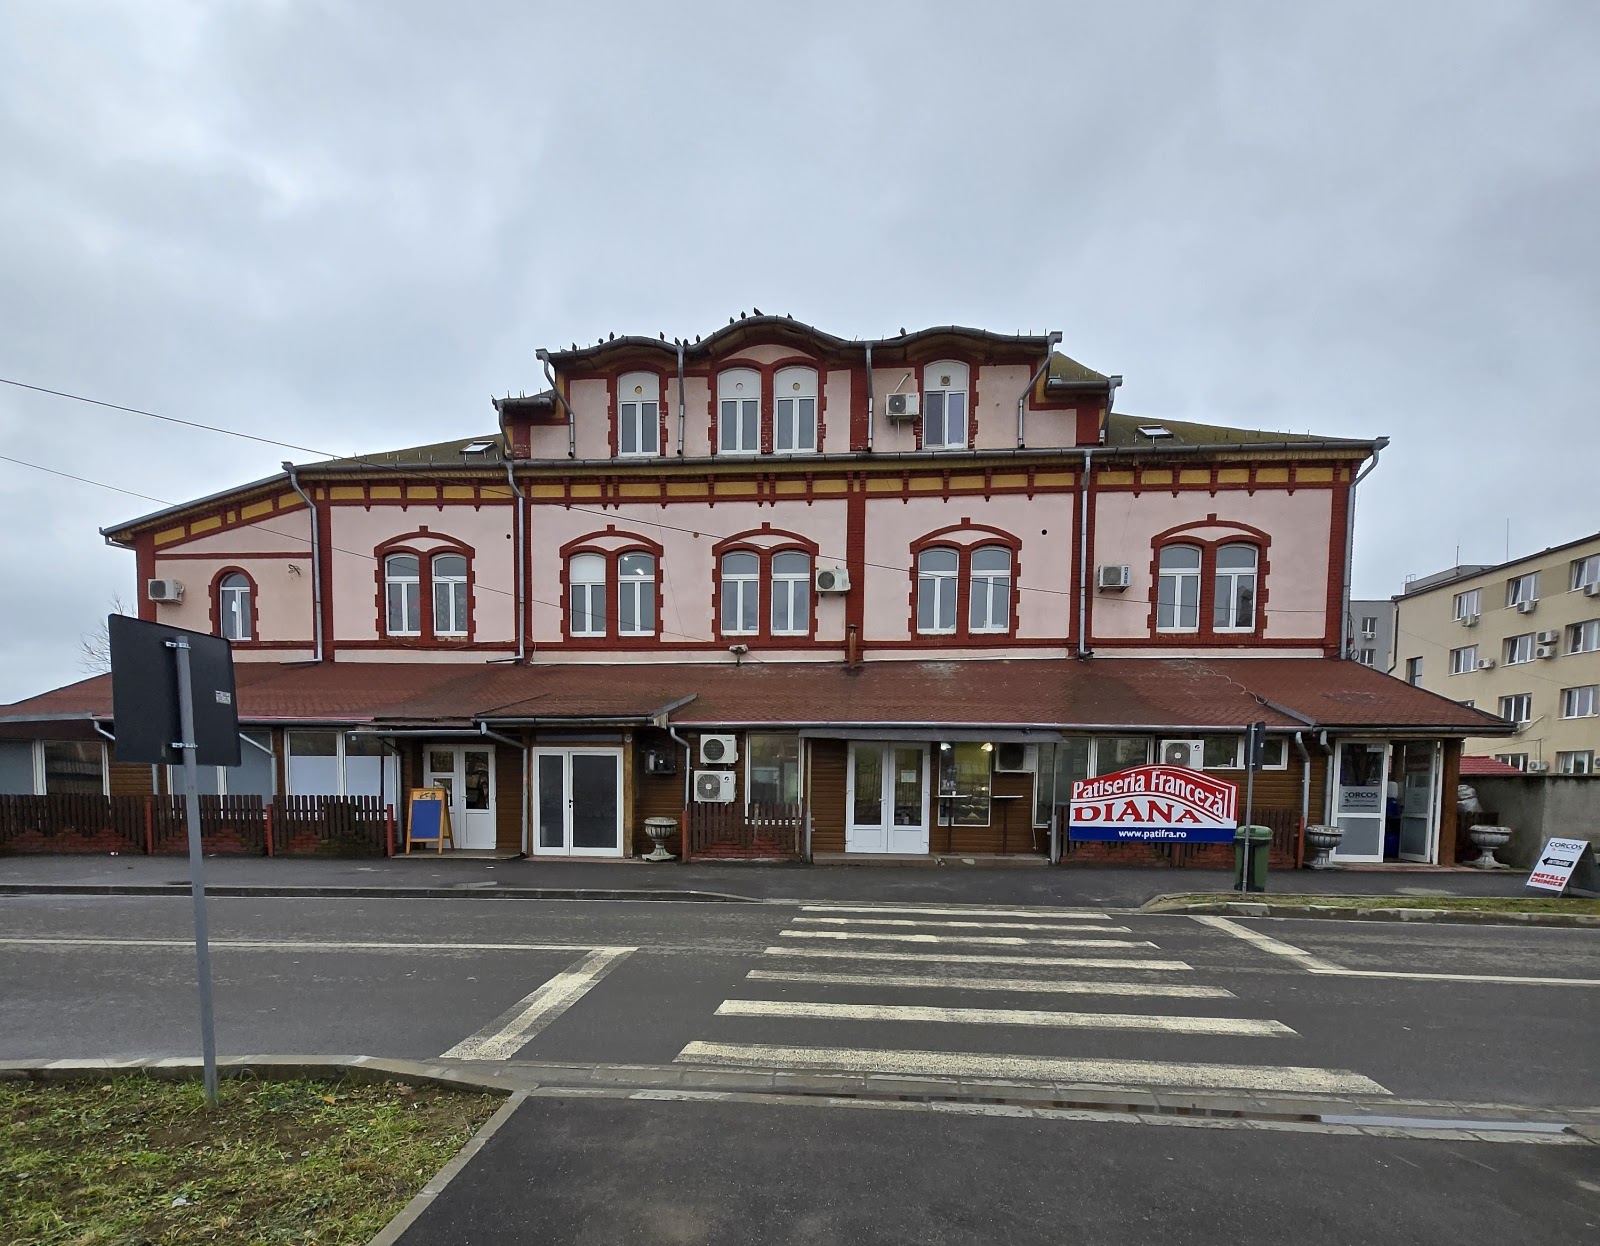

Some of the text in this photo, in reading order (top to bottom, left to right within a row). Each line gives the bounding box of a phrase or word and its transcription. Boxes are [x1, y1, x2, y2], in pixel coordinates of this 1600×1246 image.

[1073, 771, 1224, 818] Patiseria Franceză
[1073, 800, 1203, 823] DIANA
[1118, 829, 1187, 839] www.patifra.ro
[1550, 842, 1582, 850] CORCOS
